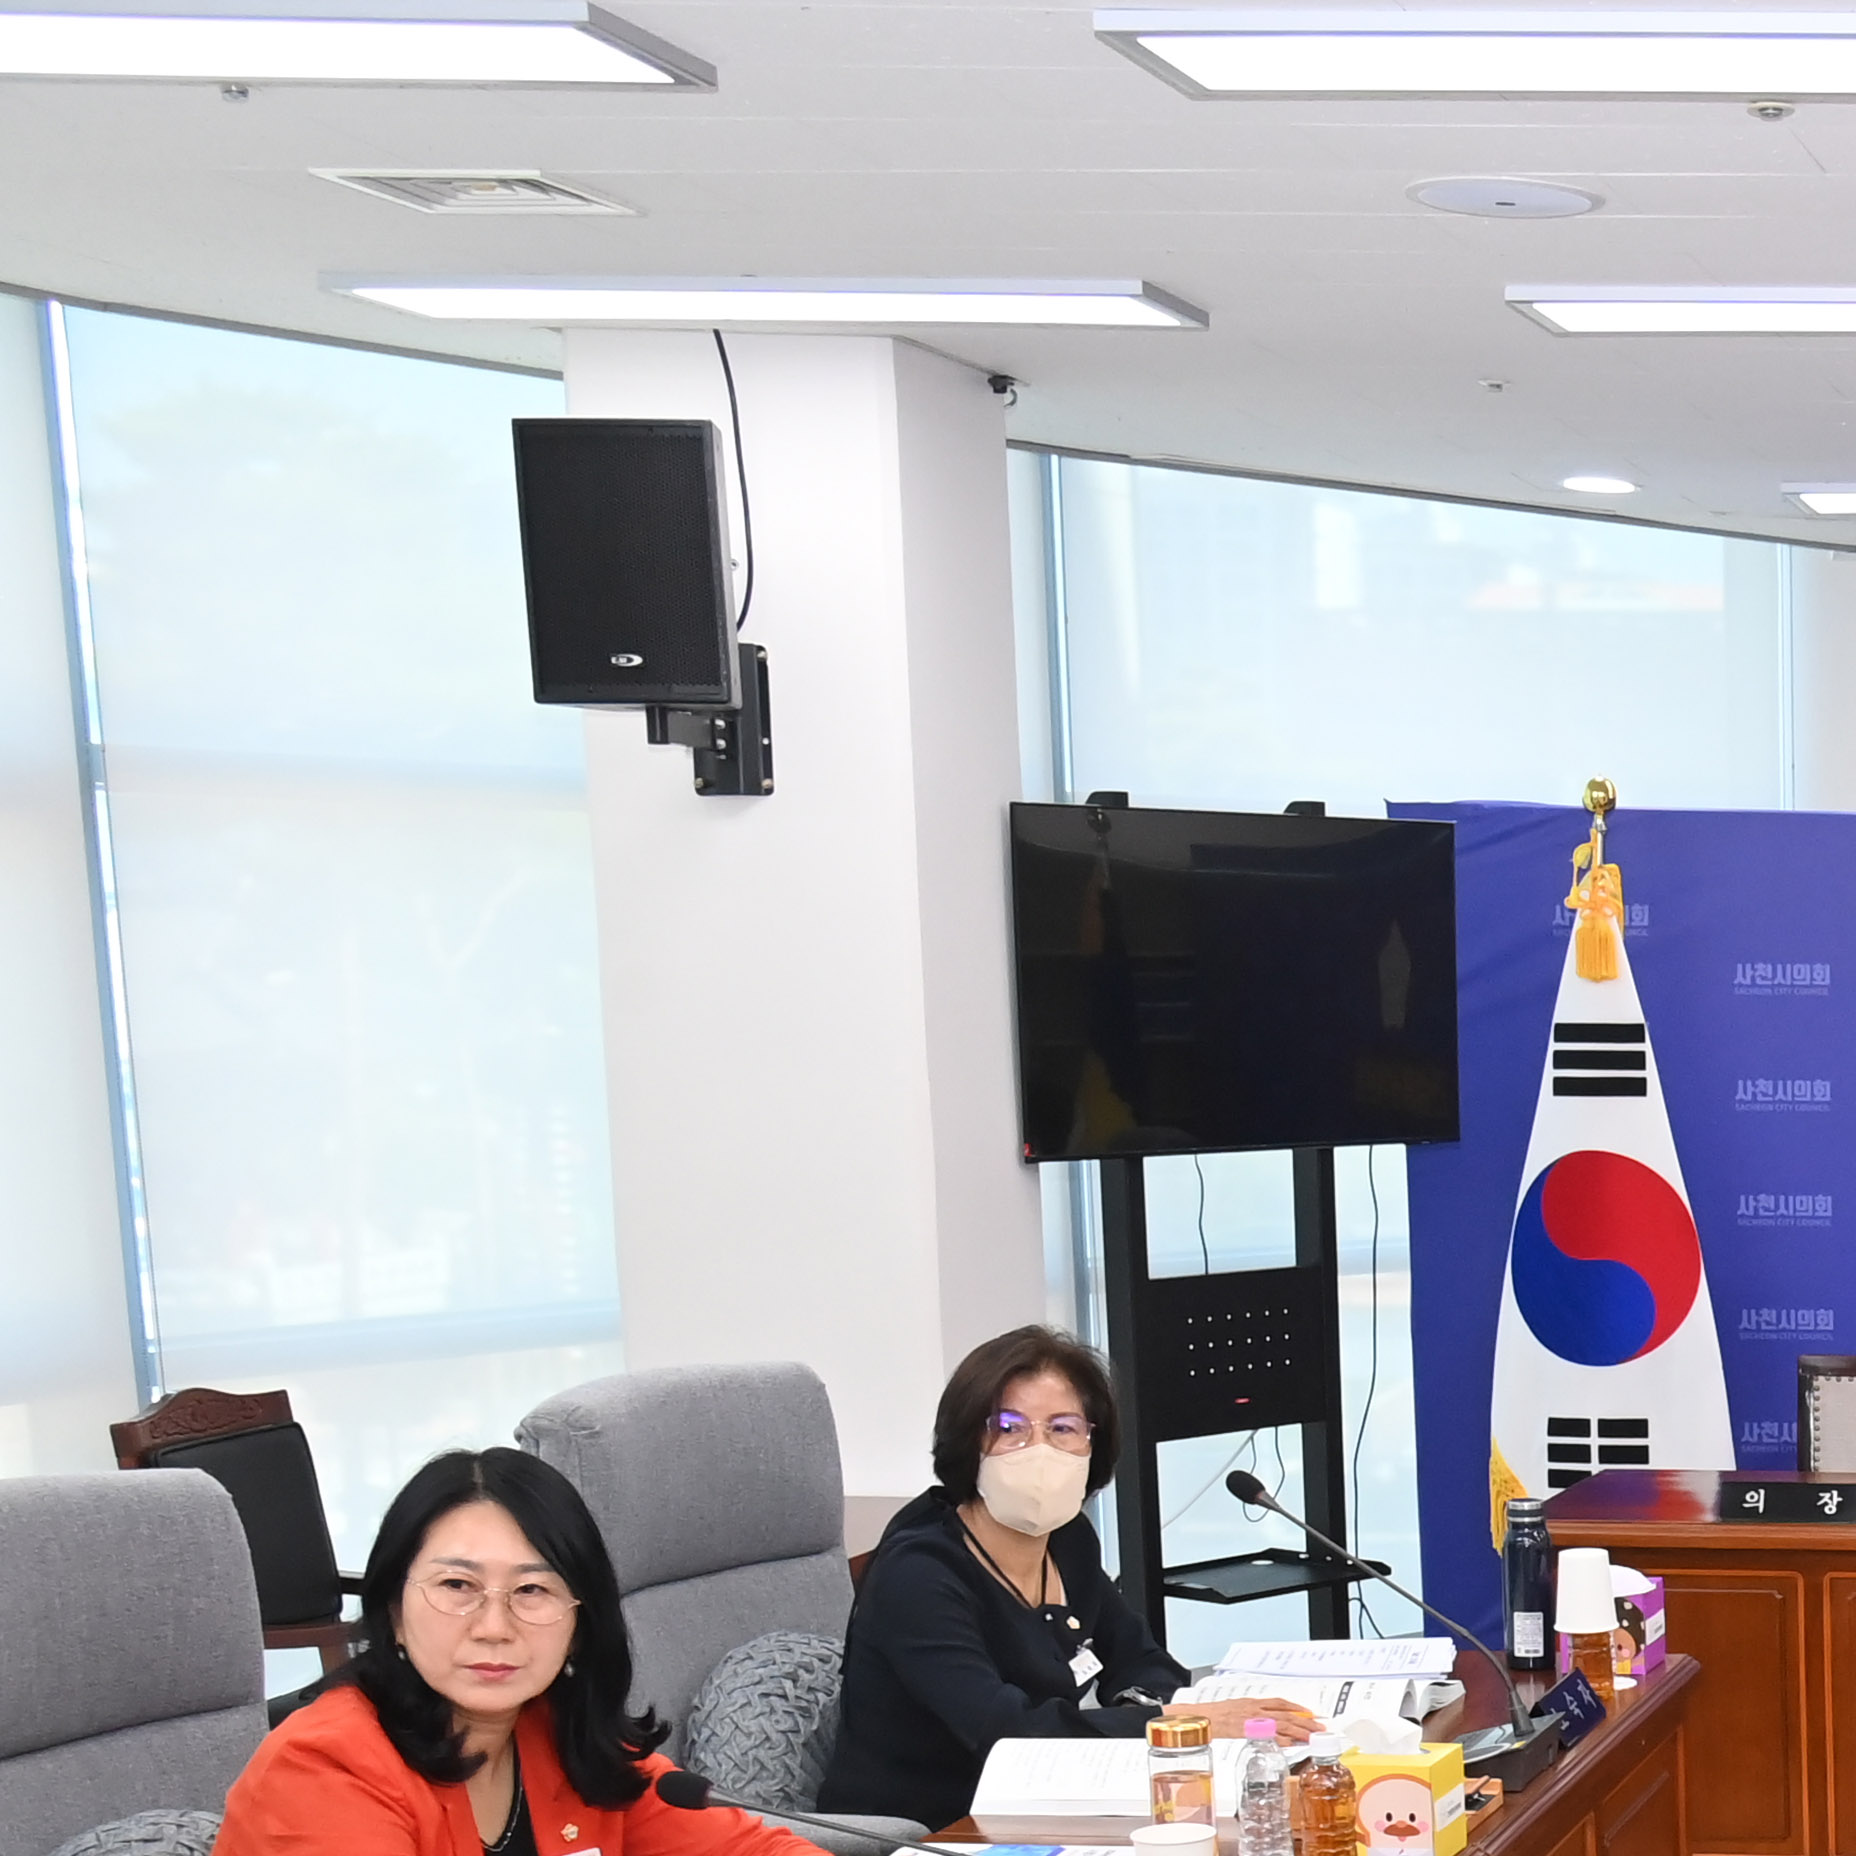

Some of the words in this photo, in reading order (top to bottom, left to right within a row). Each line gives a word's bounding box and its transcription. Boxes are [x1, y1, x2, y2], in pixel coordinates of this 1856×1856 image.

[1733, 962, 1830, 985] 사천시의회
[1735, 1078, 1831, 1101] 사천시의회
[1737, 1193, 1832, 1216] 사천시의회
[1739, 1308, 1834, 1331] 사천시의회
[1741, 1422, 1797, 1443] 사천시
[1742, 1488, 1843, 1515] 의장
